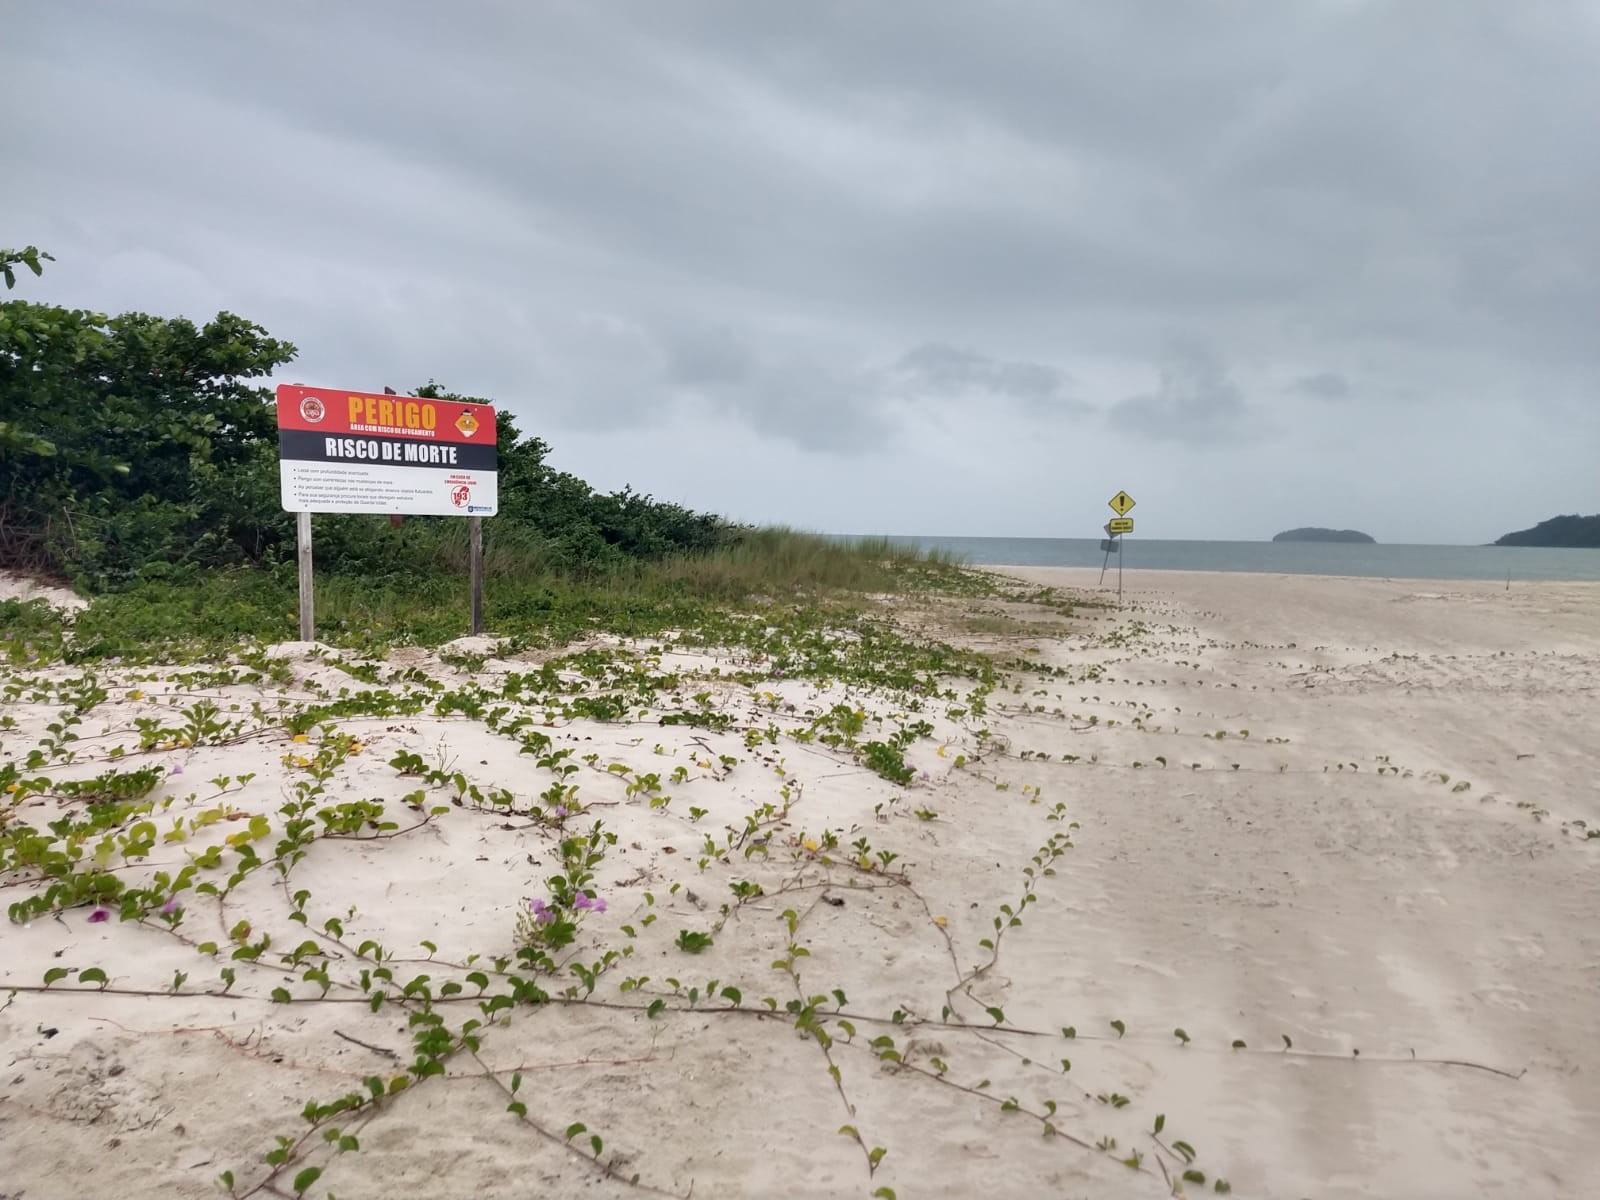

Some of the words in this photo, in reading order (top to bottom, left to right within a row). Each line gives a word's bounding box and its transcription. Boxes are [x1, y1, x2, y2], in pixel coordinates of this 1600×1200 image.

[348, 396, 436, 430] PERIGO
[377, 426, 394, 434] RISCO
[402, 428, 435, 437] AFOGAMENTO
[325, 437, 378, 460] RISCO
[382, 441, 402, 461] DE
[404, 443, 458, 465] MORTE
[452, 492, 468, 500] 193
